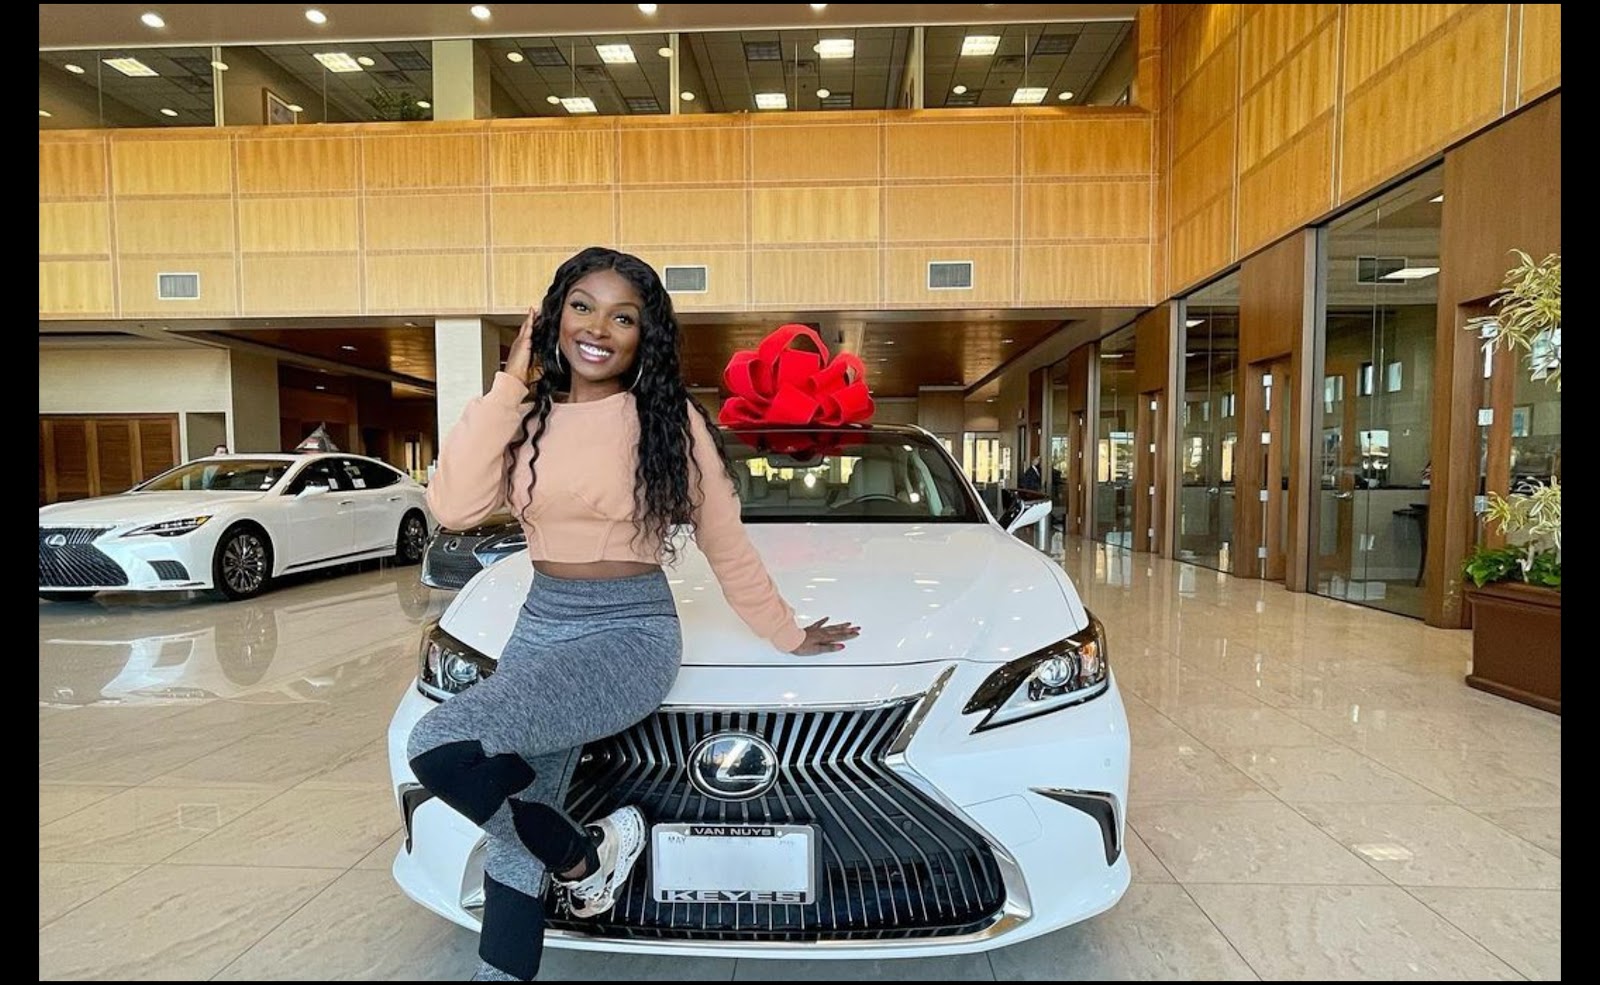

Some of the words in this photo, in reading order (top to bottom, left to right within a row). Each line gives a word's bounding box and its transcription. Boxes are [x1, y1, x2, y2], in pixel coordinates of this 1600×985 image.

[693, 827, 725, 836] VAN
[729, 827, 772, 836] NUYS
[666, 890, 802, 902] KEYES
